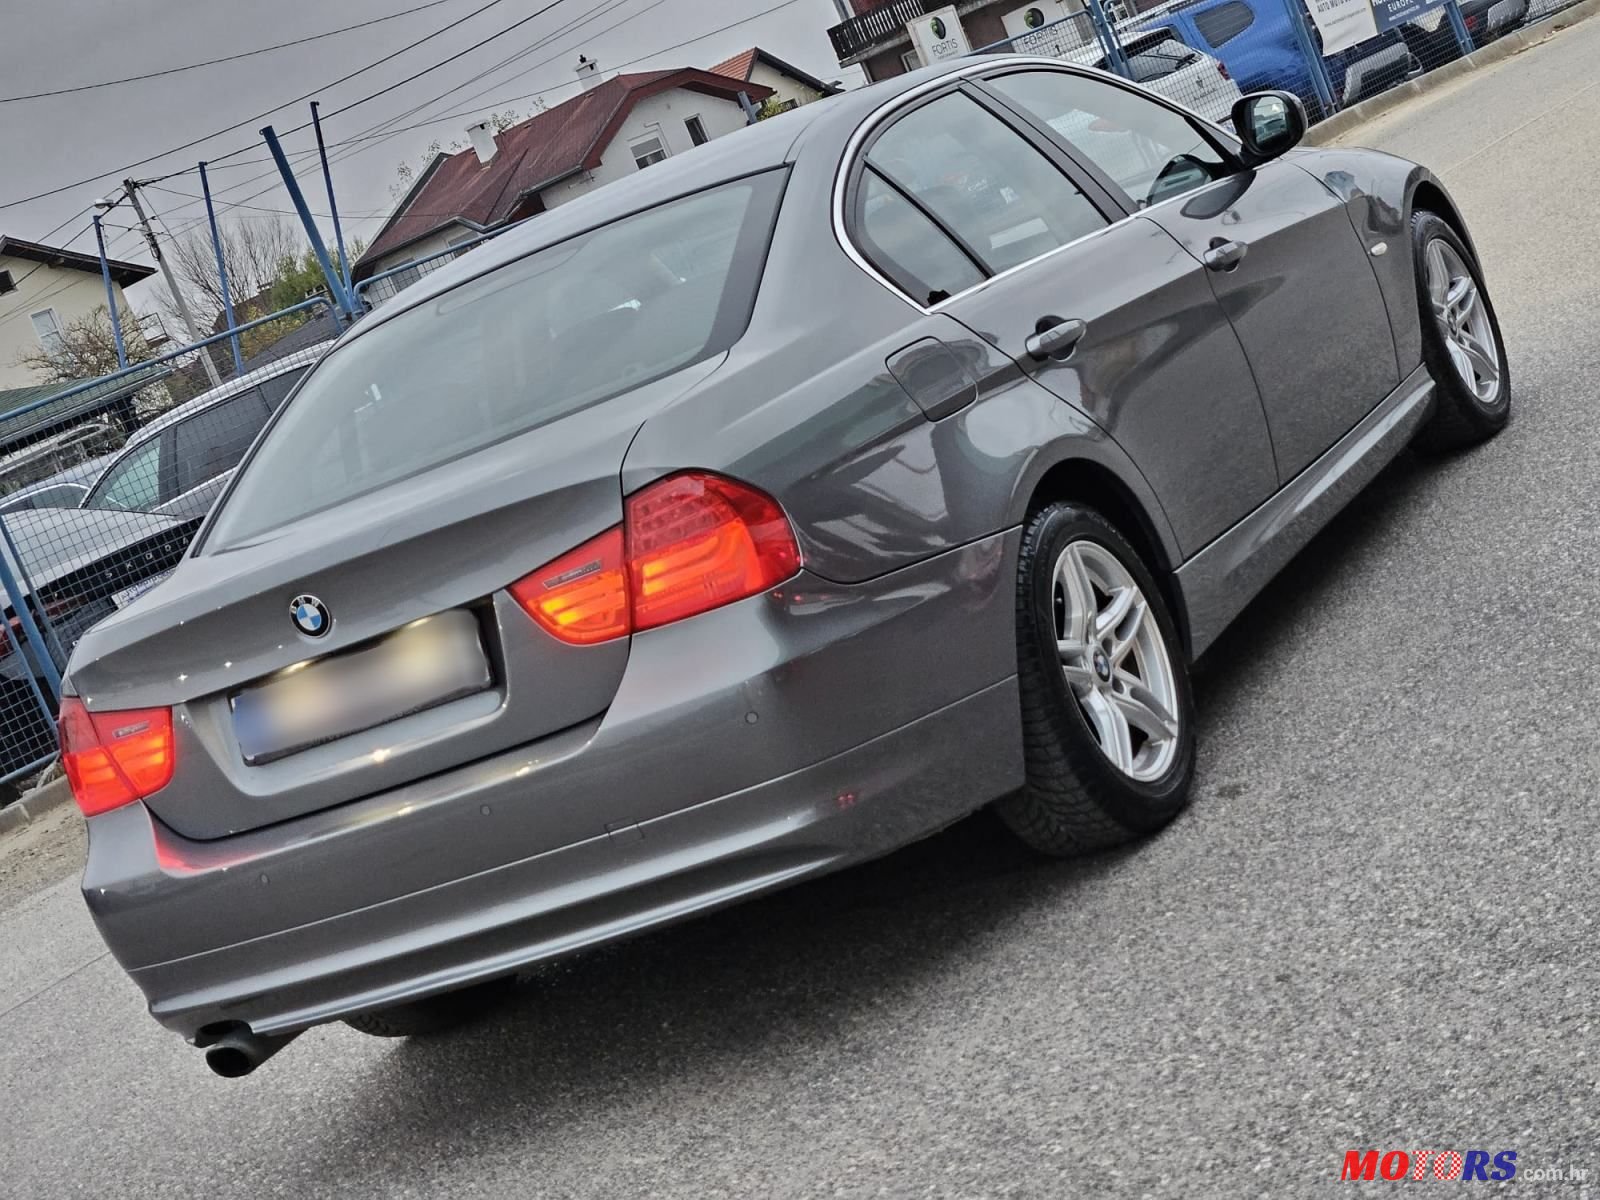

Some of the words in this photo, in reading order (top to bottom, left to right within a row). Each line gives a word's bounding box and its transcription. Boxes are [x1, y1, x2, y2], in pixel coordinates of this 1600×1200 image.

[1023, 24, 1057, 48] FORTIS
[931, 38, 958, 56] FORTIS
[290, 597, 320, 614] BMW
